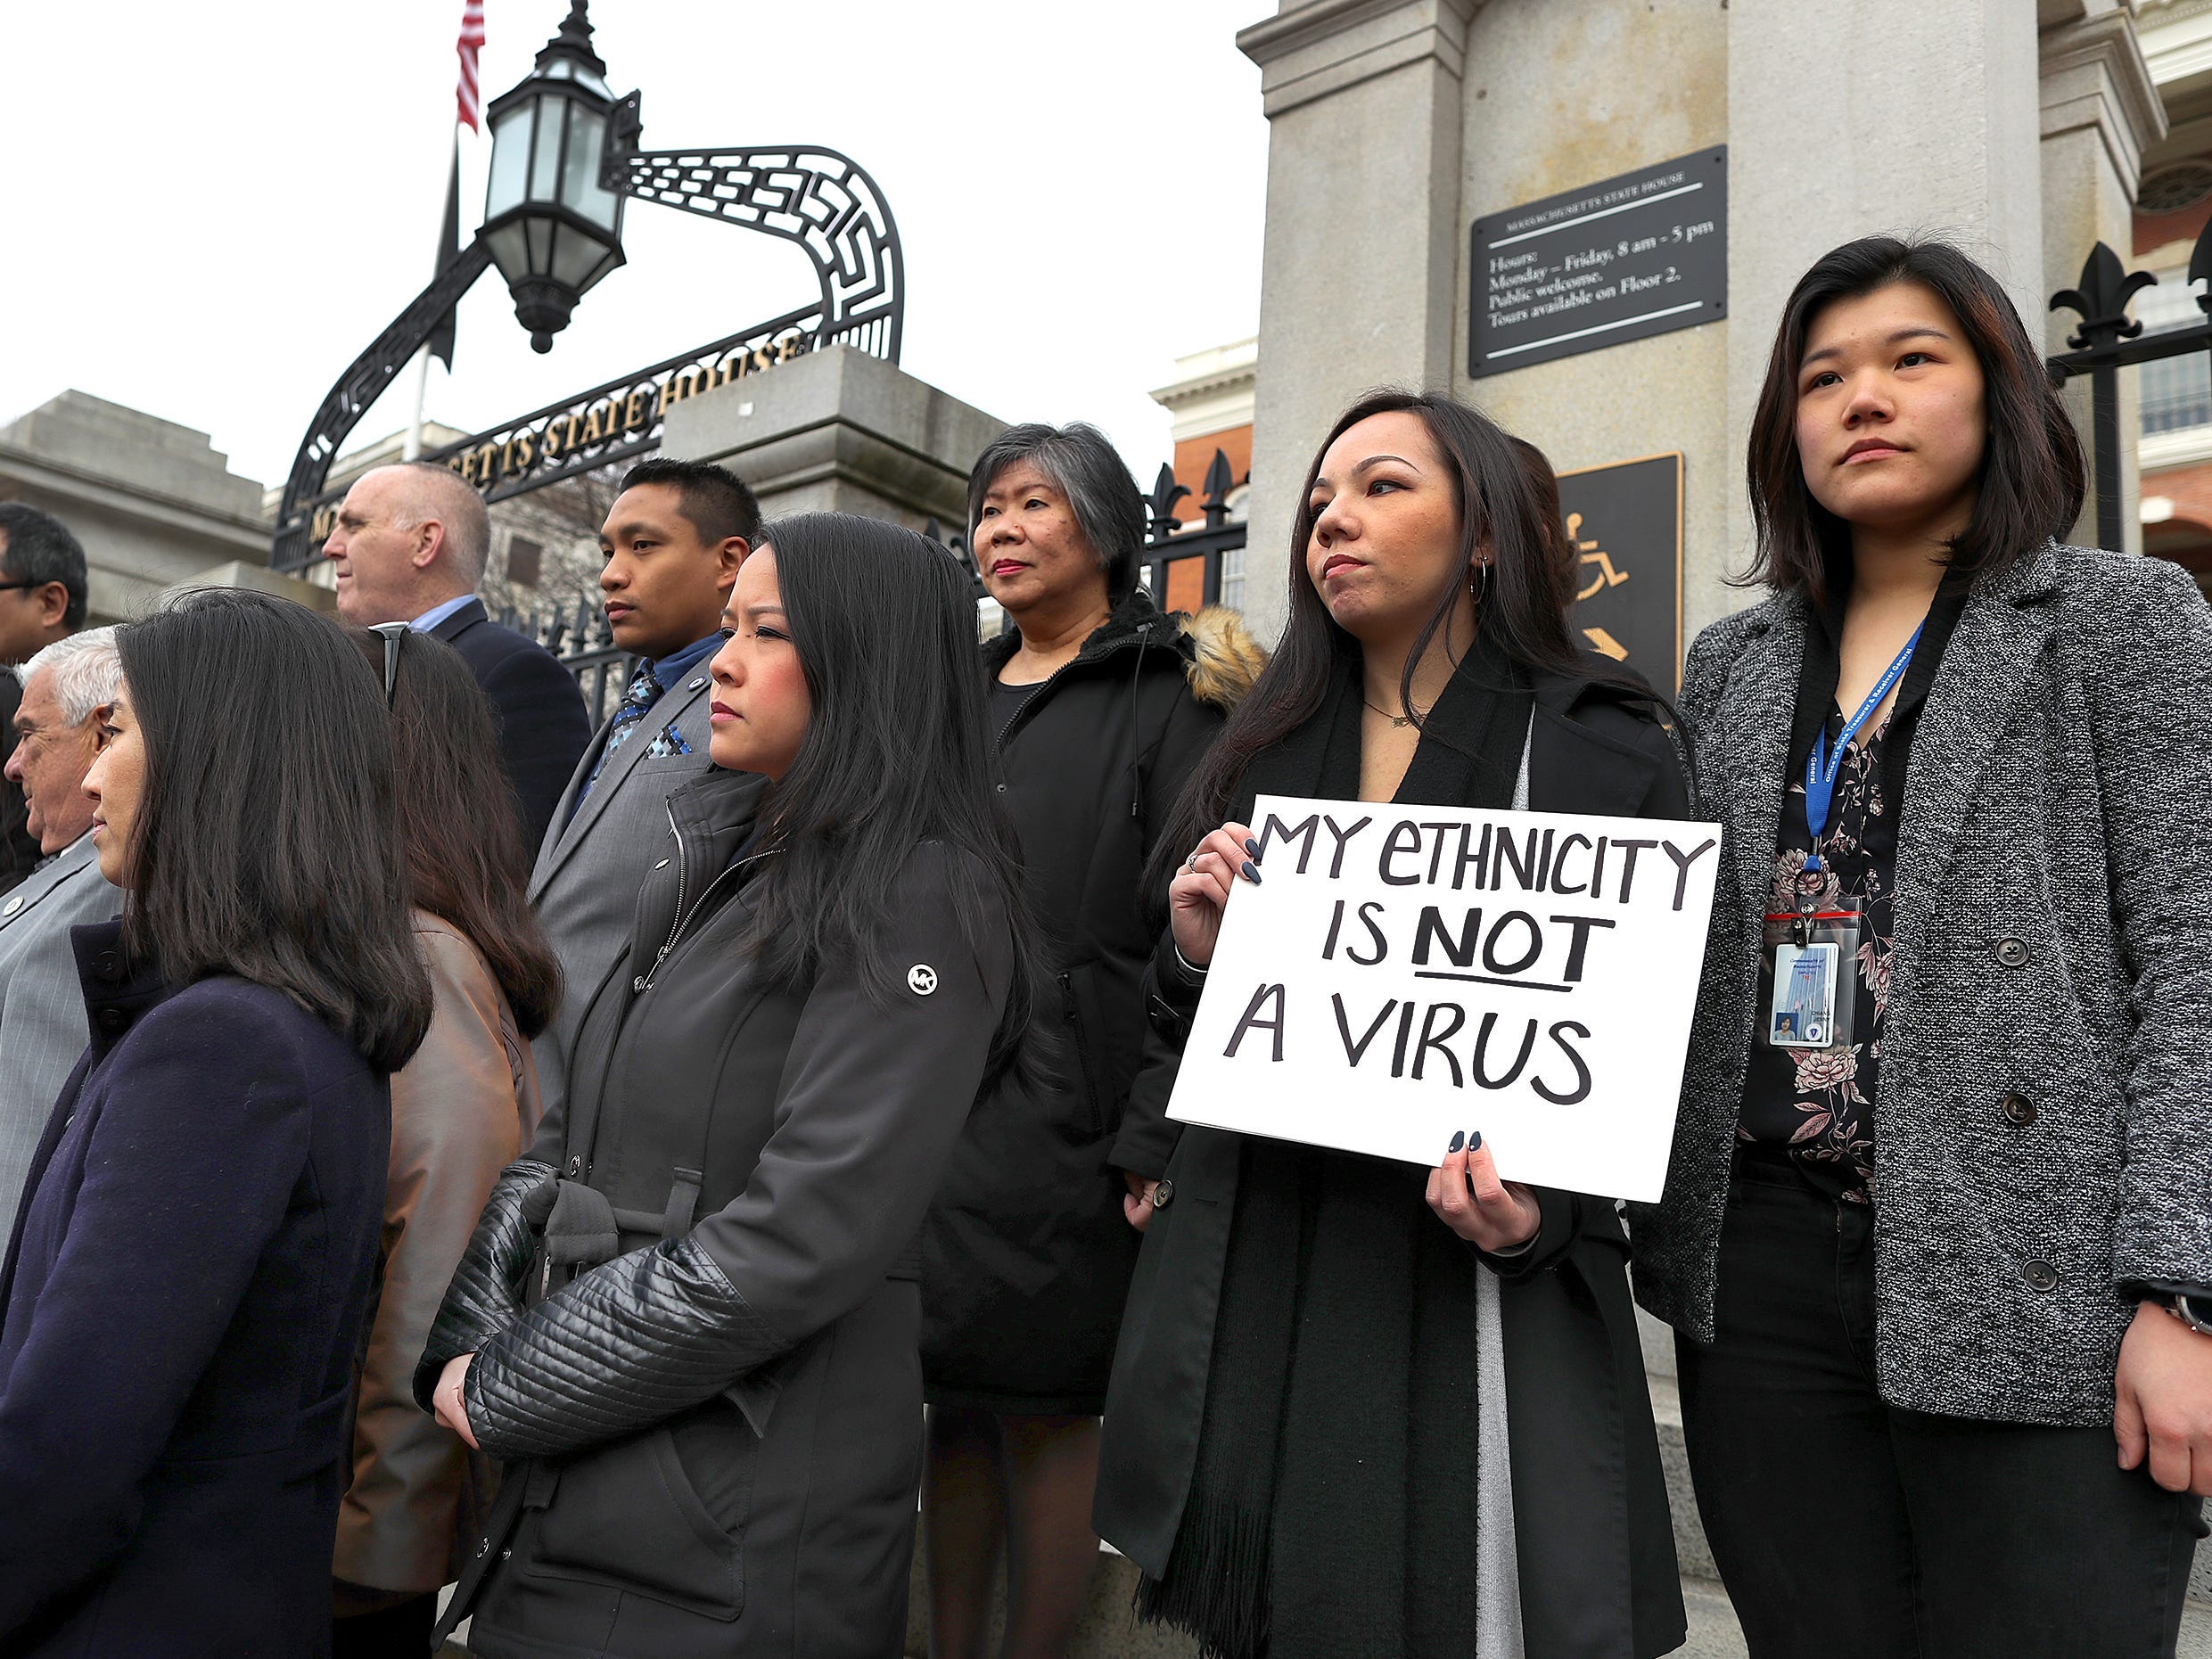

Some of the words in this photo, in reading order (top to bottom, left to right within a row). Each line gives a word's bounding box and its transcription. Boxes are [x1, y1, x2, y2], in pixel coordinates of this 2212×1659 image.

[1506, 196, 1601, 233] MASSACHUSETTS
[1603, 185, 1640, 206] STATE
[1641, 170, 1685, 193] HOUSE
[1489, 266, 1548, 292] Monday
[1617, 240, 1629, 257] 8
[1631, 236, 1657, 253] am
[1671, 225, 1683, 243] 5
[1686, 220, 1714, 242] pm
[1489, 251, 1538, 274] Hours:
[1487, 310, 1529, 328] Tours
[1530, 288, 1593, 318] available
[1595, 286, 1616, 300] on
[1620, 275, 1663, 294] Floor
[1665, 266, 1682, 283] 2.
[1489, 287, 1534, 310] Public
[1535, 272, 1604, 297] welcome.
[543, 392, 645, 456] STATE
[1825, 760, 1836, 783] Office
[1837, 733, 1849, 750] State
[1846, 703, 1871, 732] Treasurer
[1872, 671, 1895, 698] Receiver
[1892, 648, 1912, 671] General
[1810, 757, 1818, 784] General
[1253, 814, 1373, 879] MY
[1322, 900, 1388, 965] IS
[1411, 906, 1616, 982] NOT
[1223, 983, 1285, 1062] A
[1331, 992, 1592, 1105] VIRUS
